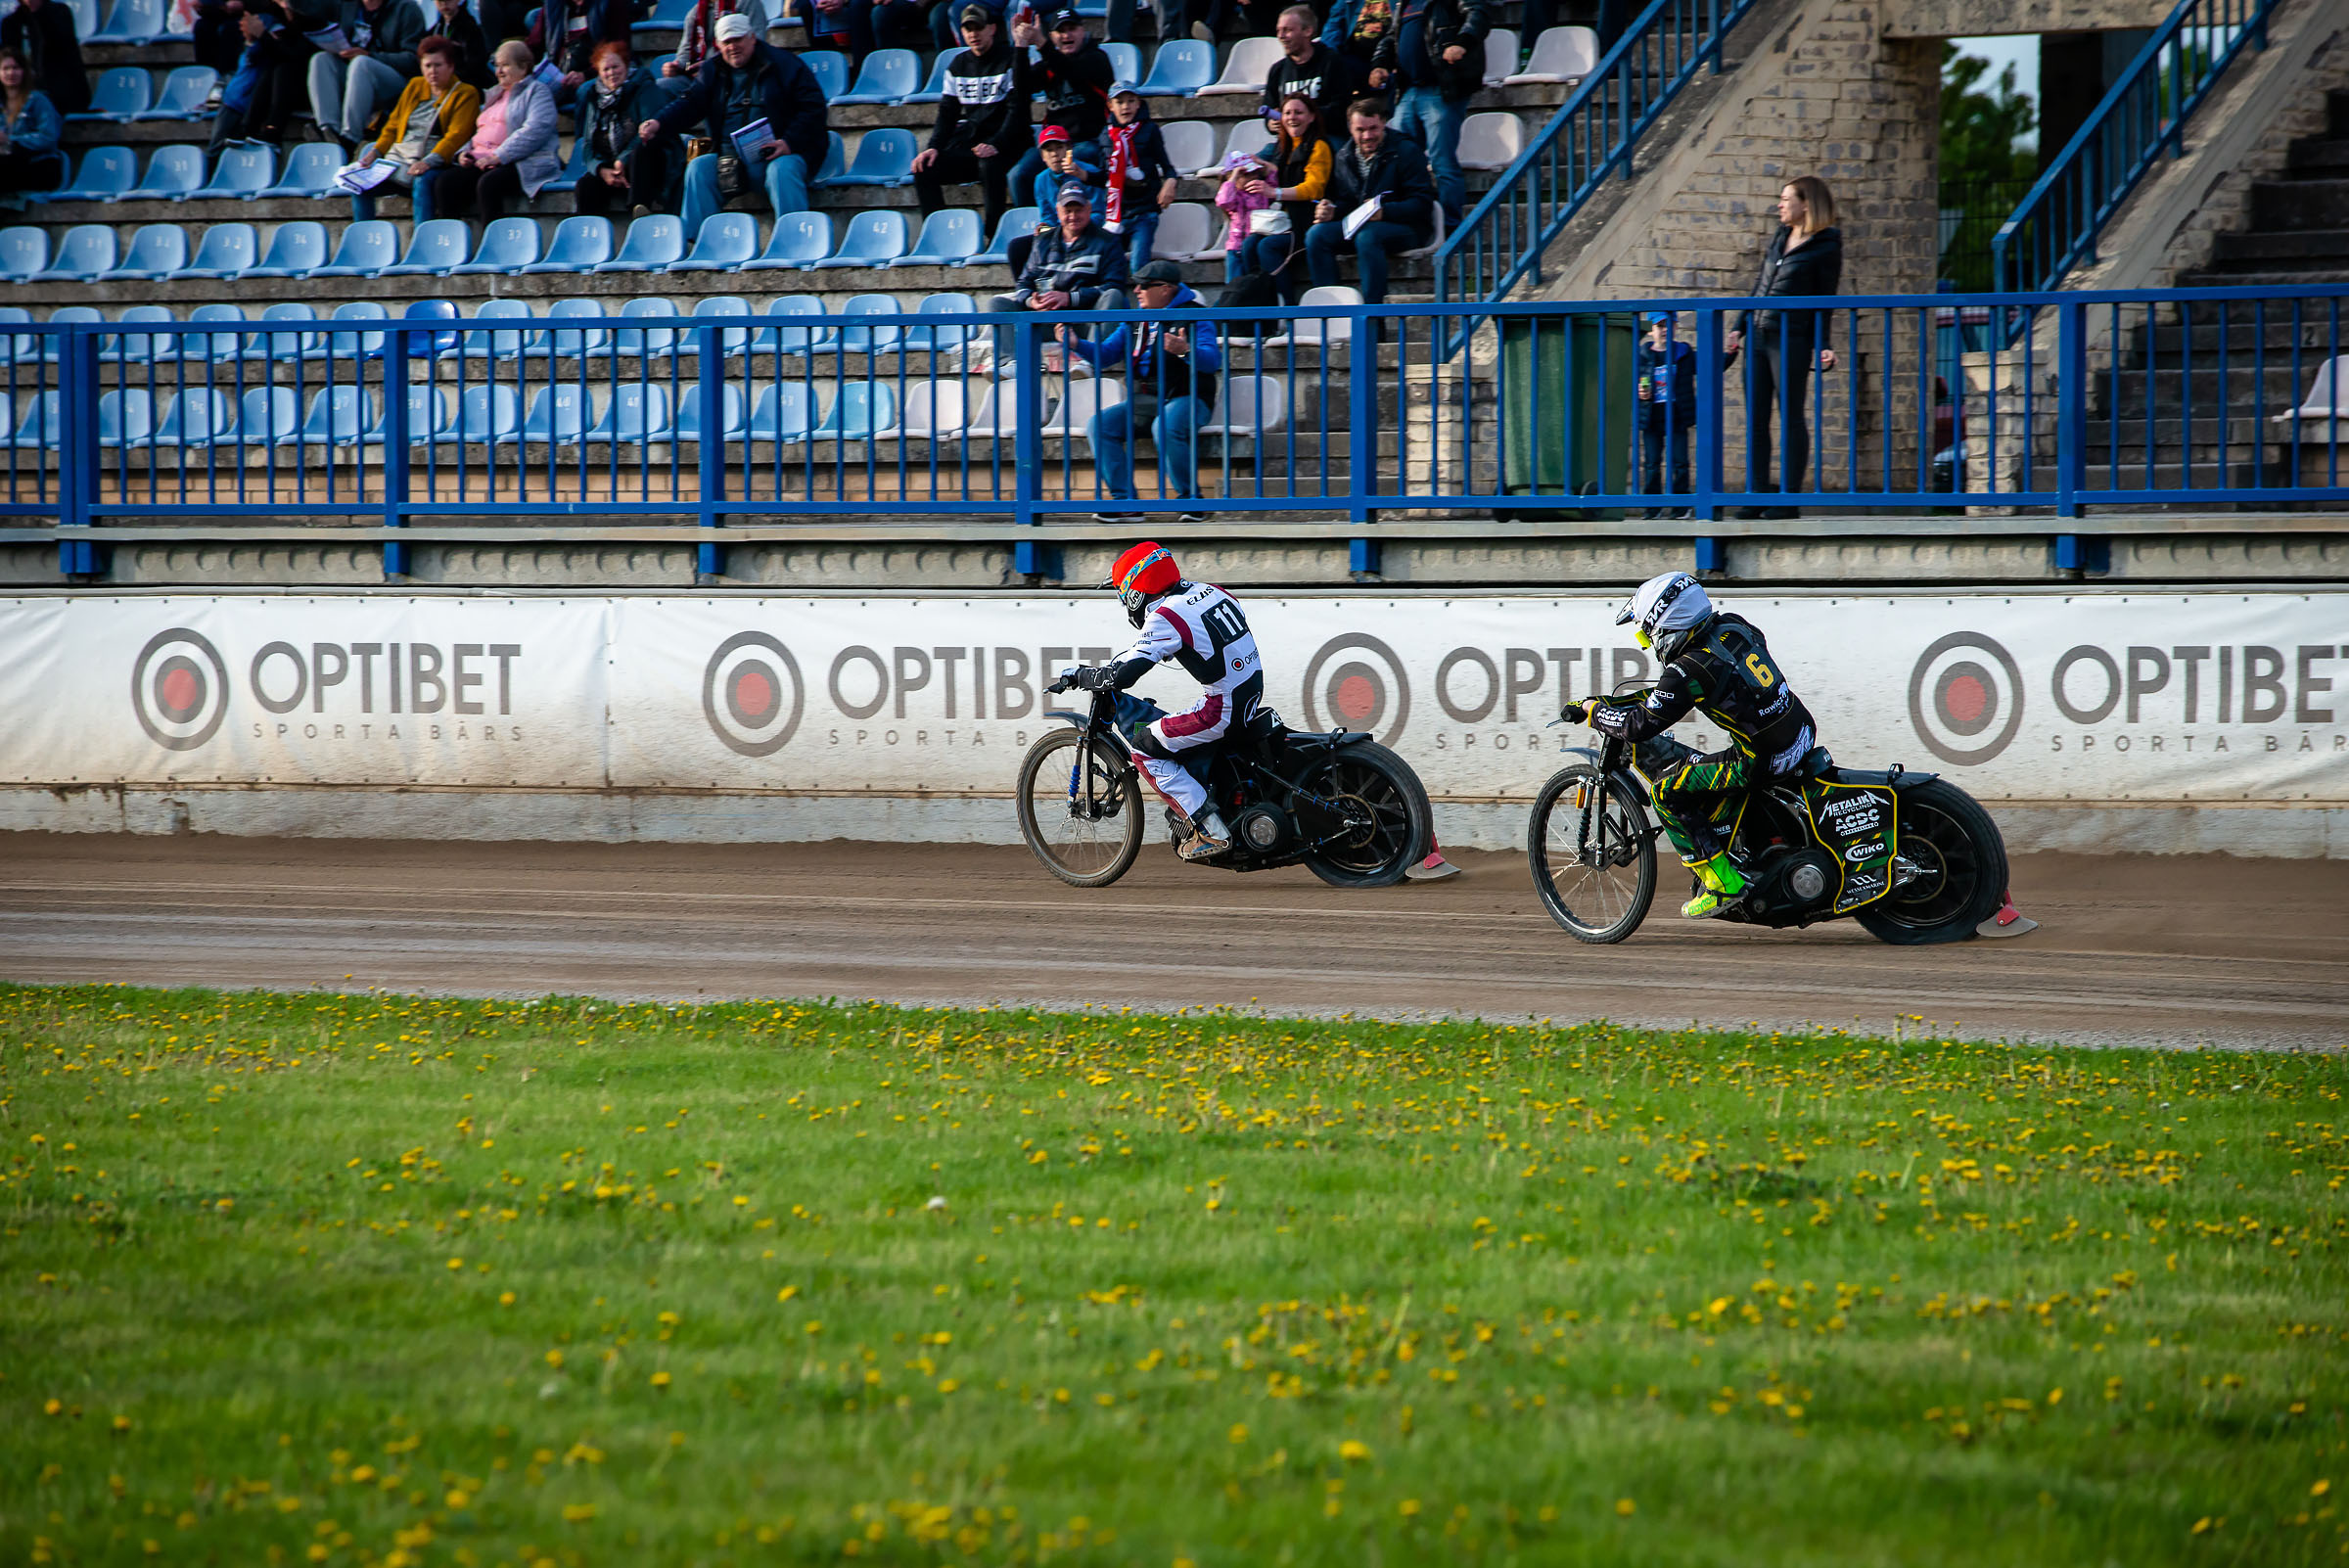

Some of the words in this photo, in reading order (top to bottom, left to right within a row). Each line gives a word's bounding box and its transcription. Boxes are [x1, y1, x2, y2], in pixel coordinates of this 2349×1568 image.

[872, 221, 888, 234] 42
[1214, 603, 1244, 636] 11
[251, 641, 521, 715] OPTIBET
[1746, 653, 1773, 687] 6
[1436, 647, 1696, 723] OPTIB
[2051, 645, 2349, 724] OPTIBE
[253, 723, 400, 739] SPORTA
[431, 721, 522, 741] BĀRS
[830, 729, 985, 746] SPORTA
[1436, 733, 1598, 750] SPORTA
[2051, 736, 2229, 752] SPORTA
[2265, 731, 2348, 752] BĀR
[1819, 790, 1890, 825] METALIKA
[1833, 803, 1872, 817] RECYCLING
[1835, 808, 1880, 832] ACDC
[1853, 843, 1885, 857] WIKO
